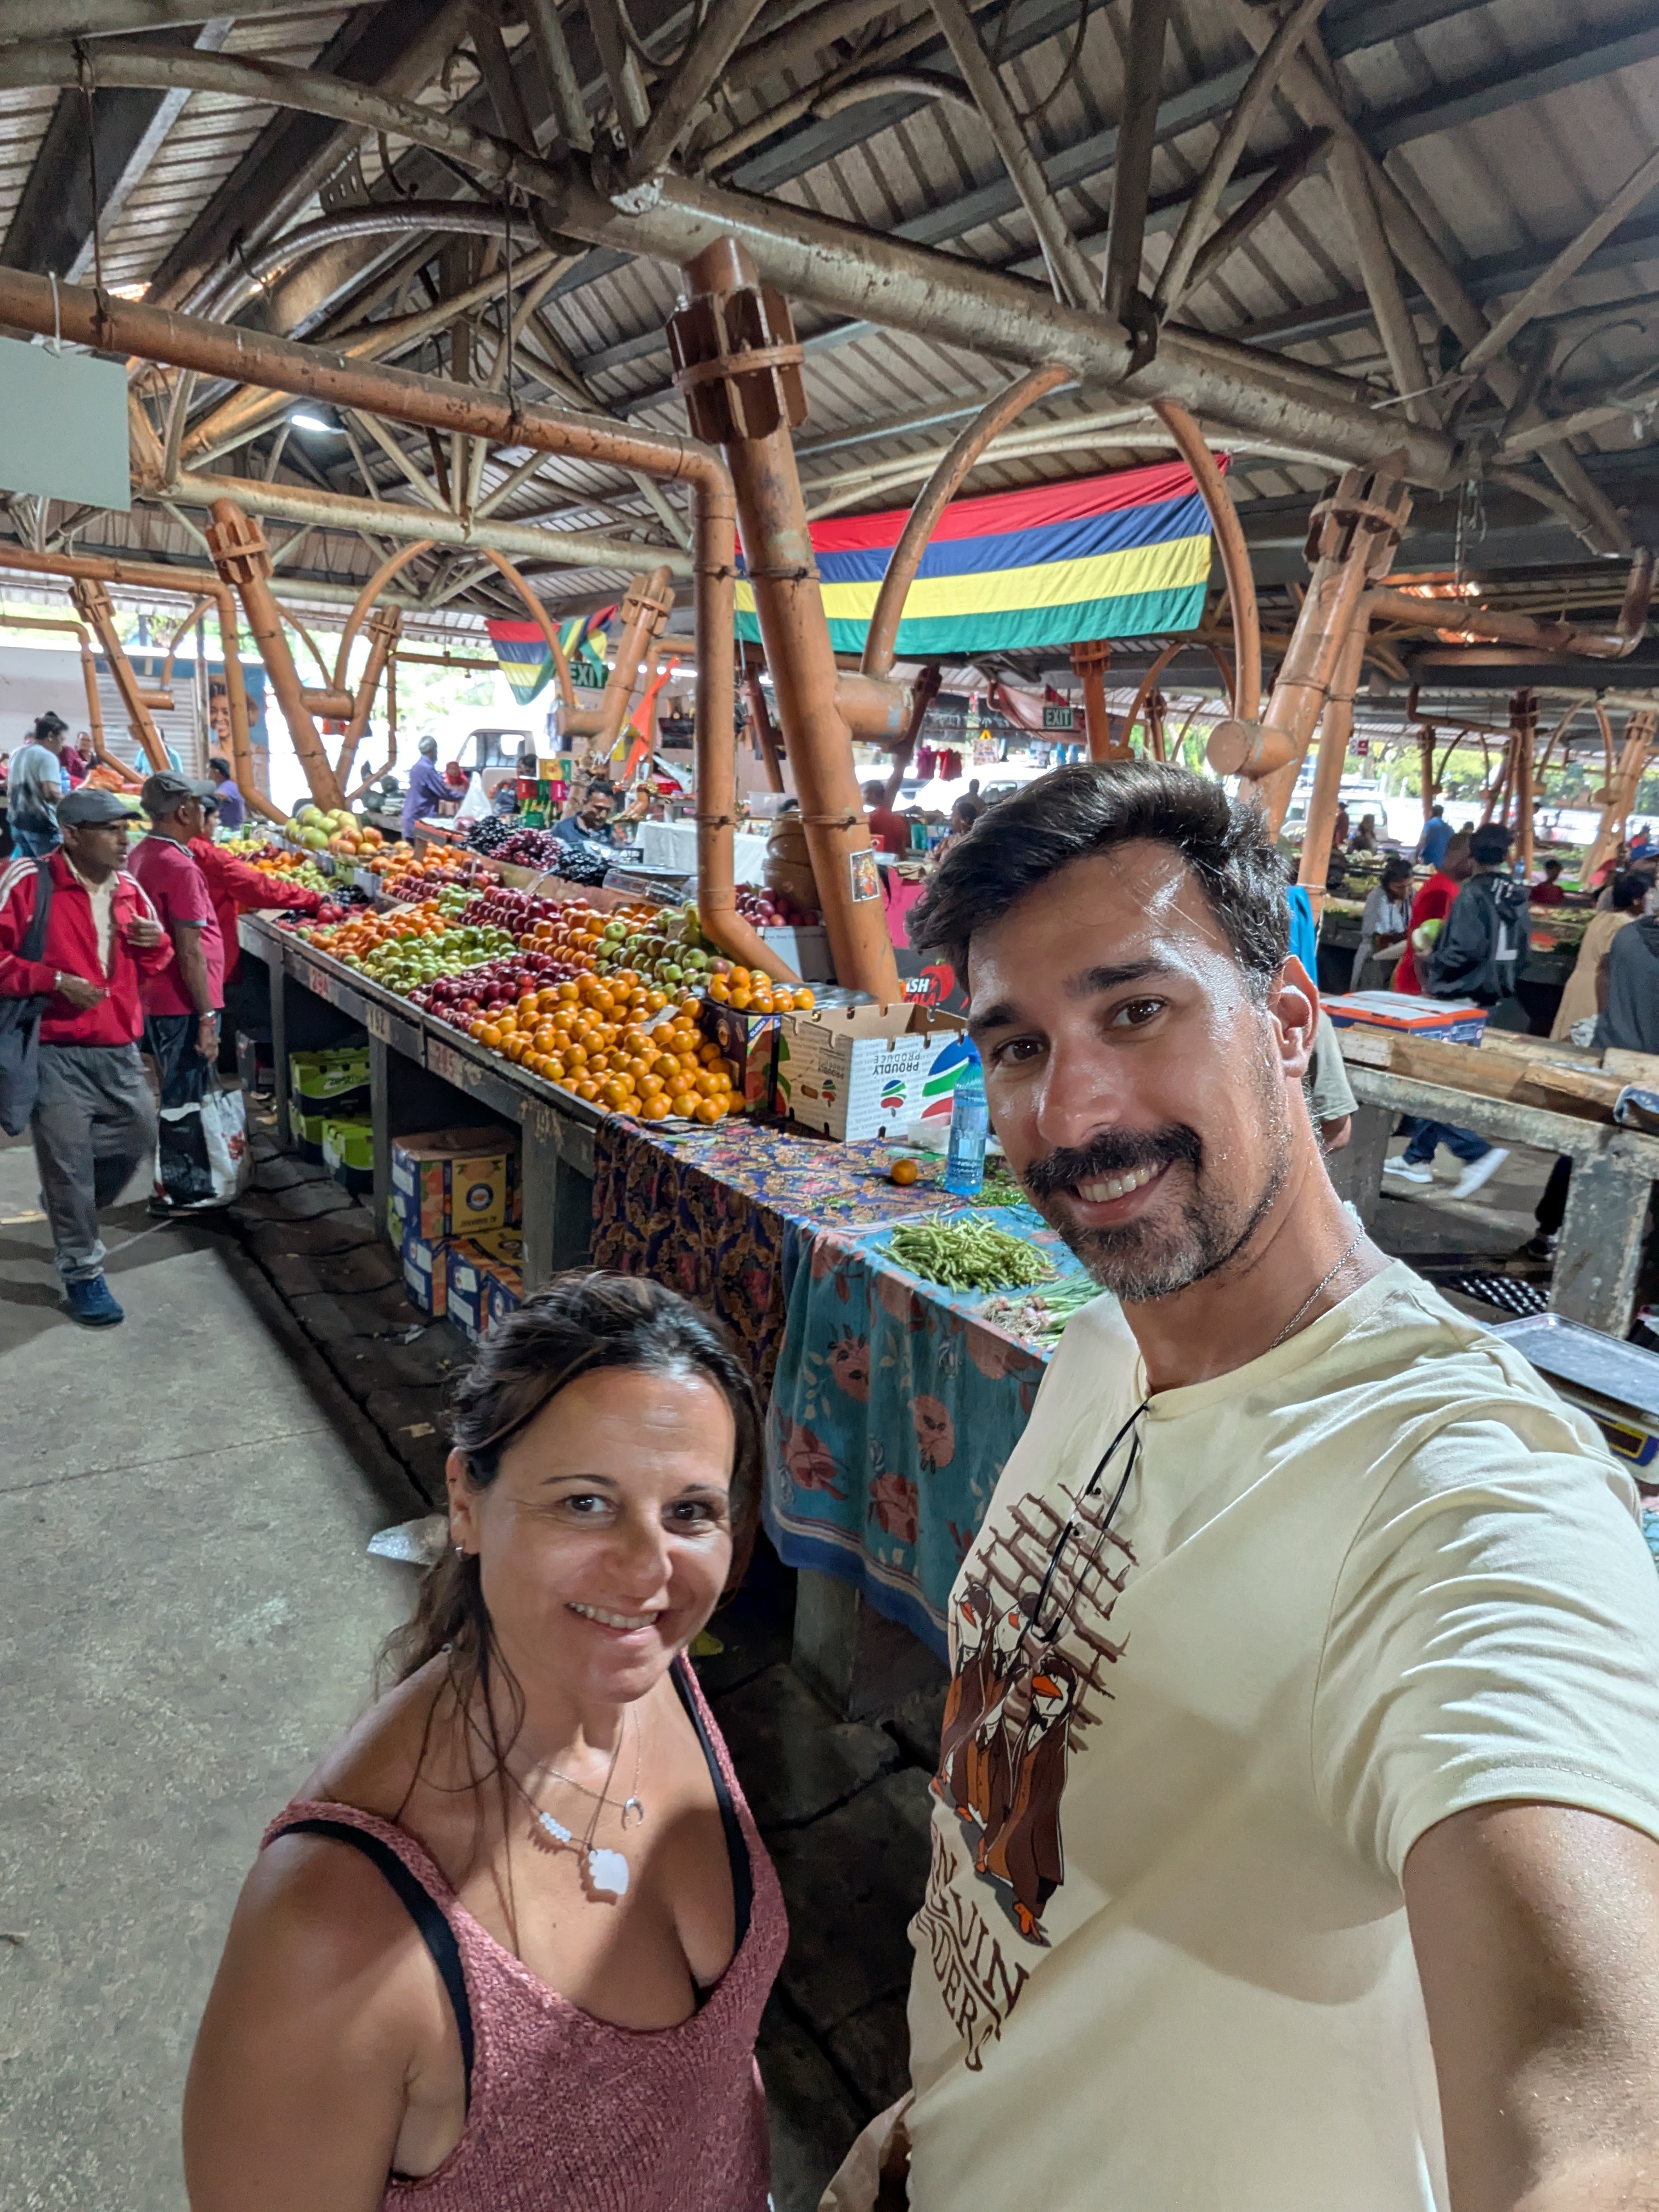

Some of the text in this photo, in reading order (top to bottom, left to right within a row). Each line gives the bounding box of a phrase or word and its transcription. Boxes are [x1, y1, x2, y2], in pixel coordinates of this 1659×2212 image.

[1046, 709, 1070, 726] EXIT
[749, 1022, 763, 1037] CLASS
[874, 1052, 921, 1064] PRODUCE
[873, 1062, 919, 1075] PROUDLY
